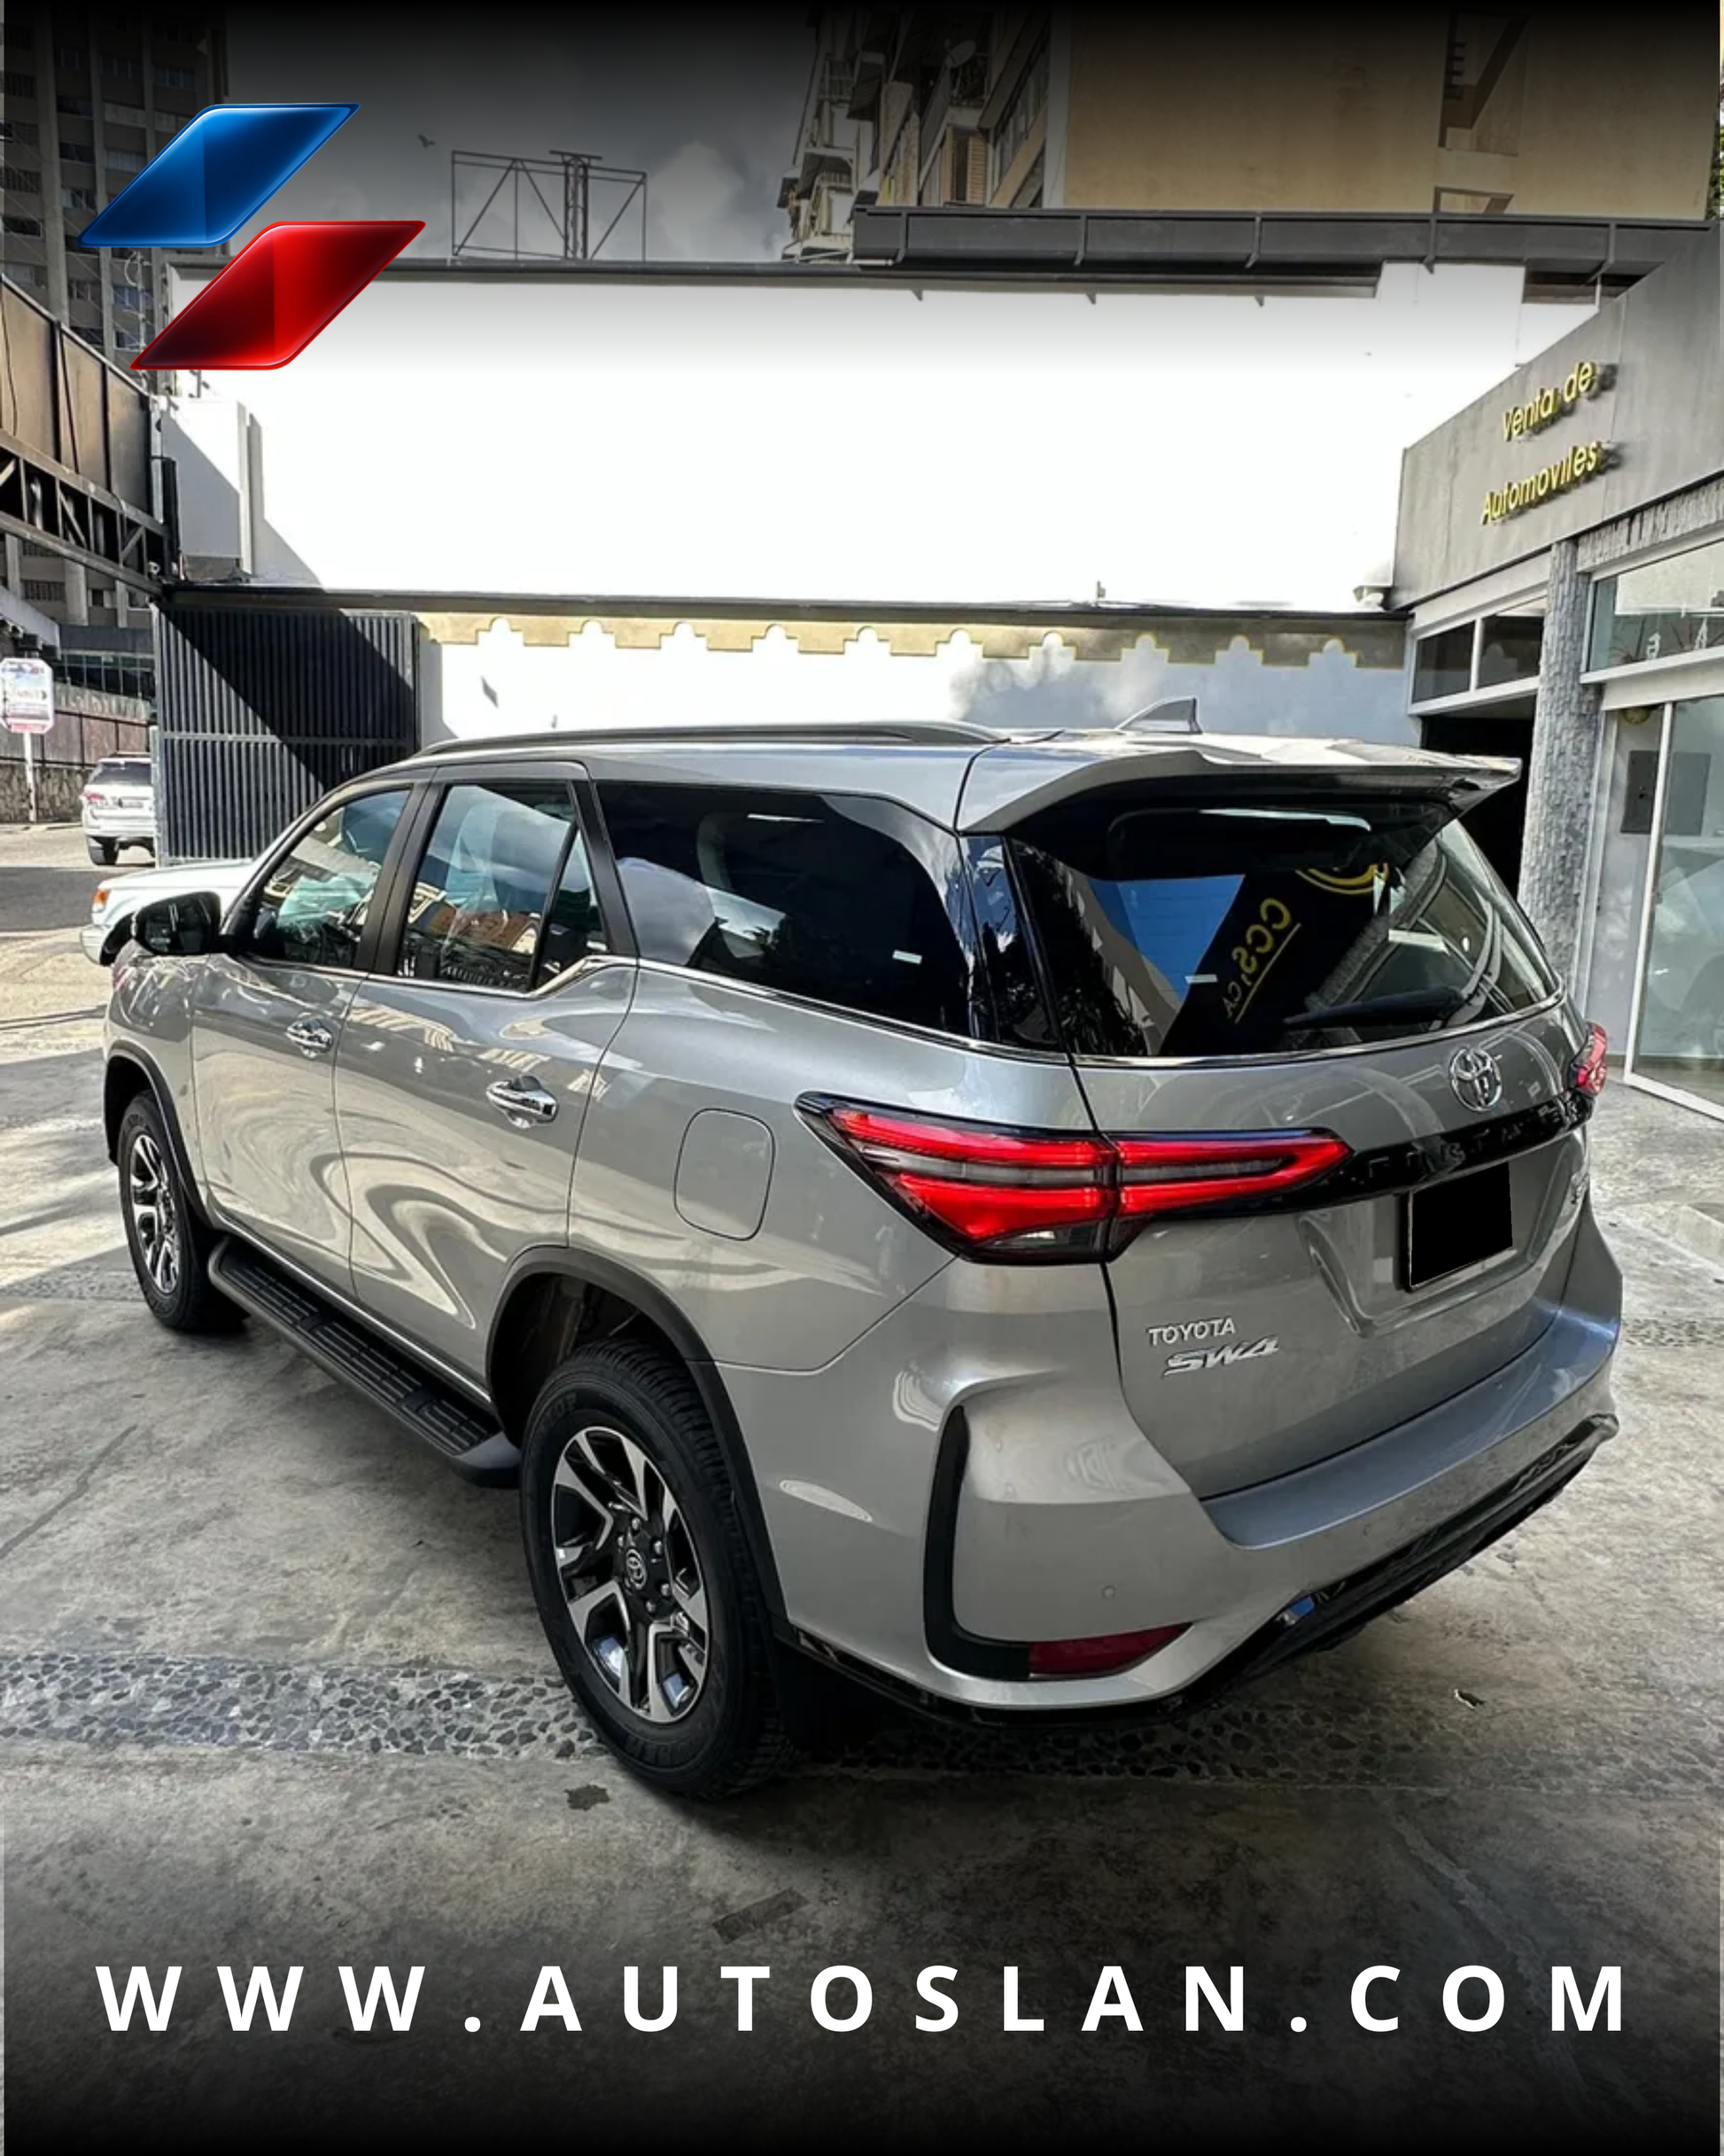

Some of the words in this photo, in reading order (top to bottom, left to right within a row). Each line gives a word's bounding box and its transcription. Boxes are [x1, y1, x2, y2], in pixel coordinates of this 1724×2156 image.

[1503, 388, 1557, 441] Venta
[1564, 362, 1596, 401] de
[1482, 441, 1601, 525] Automoviles
[1148, 1317, 1236, 1346] TOYOTA
[1163, 1336, 1279, 1376] SW4
